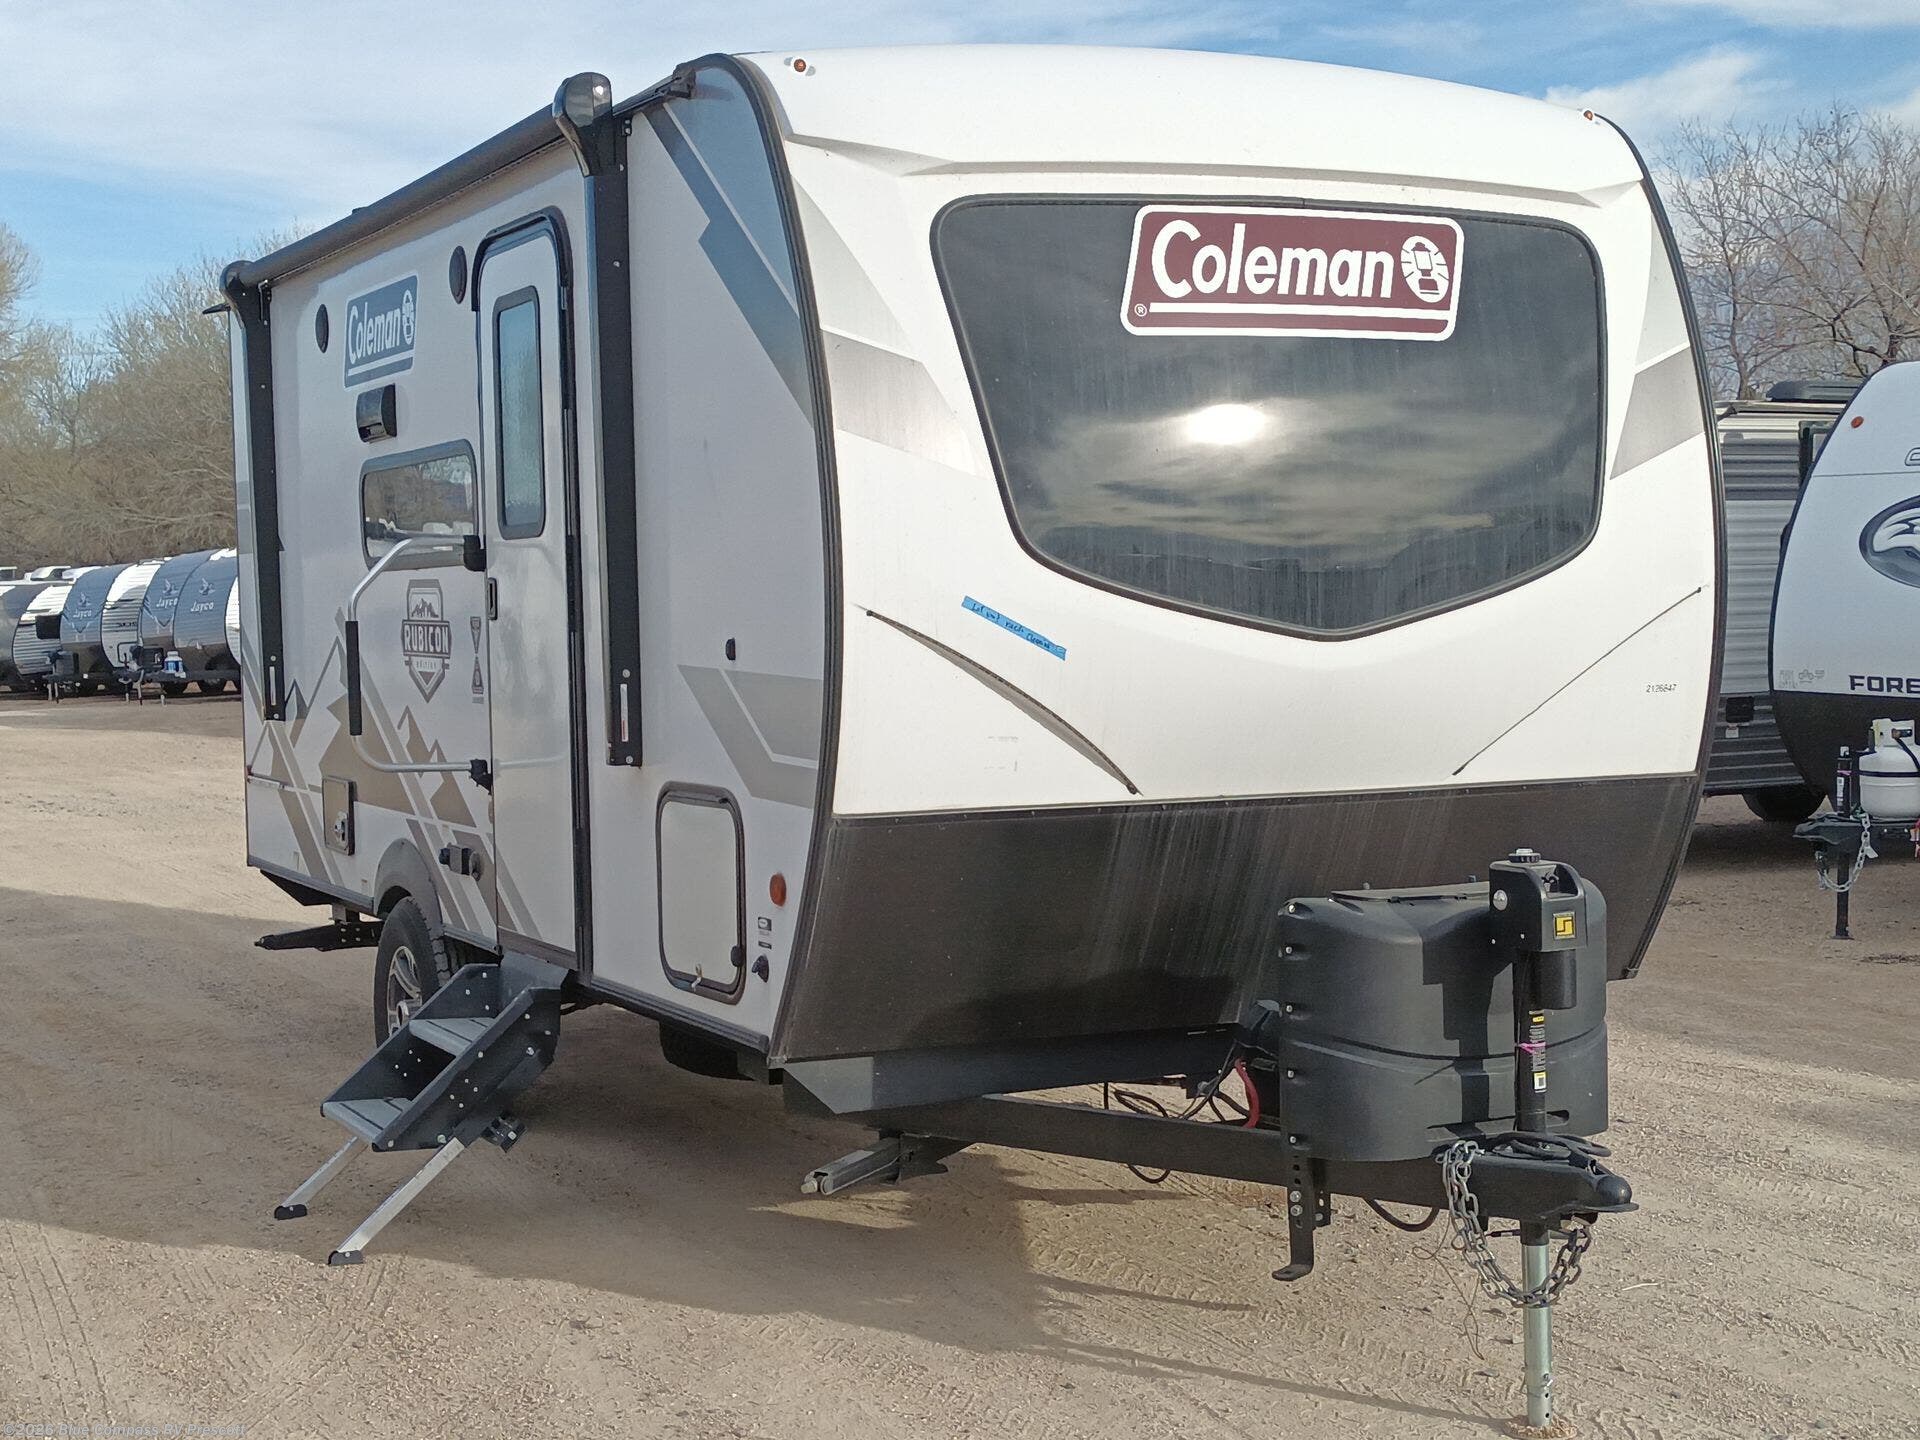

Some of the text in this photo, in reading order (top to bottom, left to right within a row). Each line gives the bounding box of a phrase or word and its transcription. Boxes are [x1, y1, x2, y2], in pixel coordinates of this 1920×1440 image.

[1151, 219, 1394, 298] Coleman
[348, 302, 400, 364] Coleman
[190, 600, 214, 613] Jayco
[404, 623, 449, 654] RUBICON
